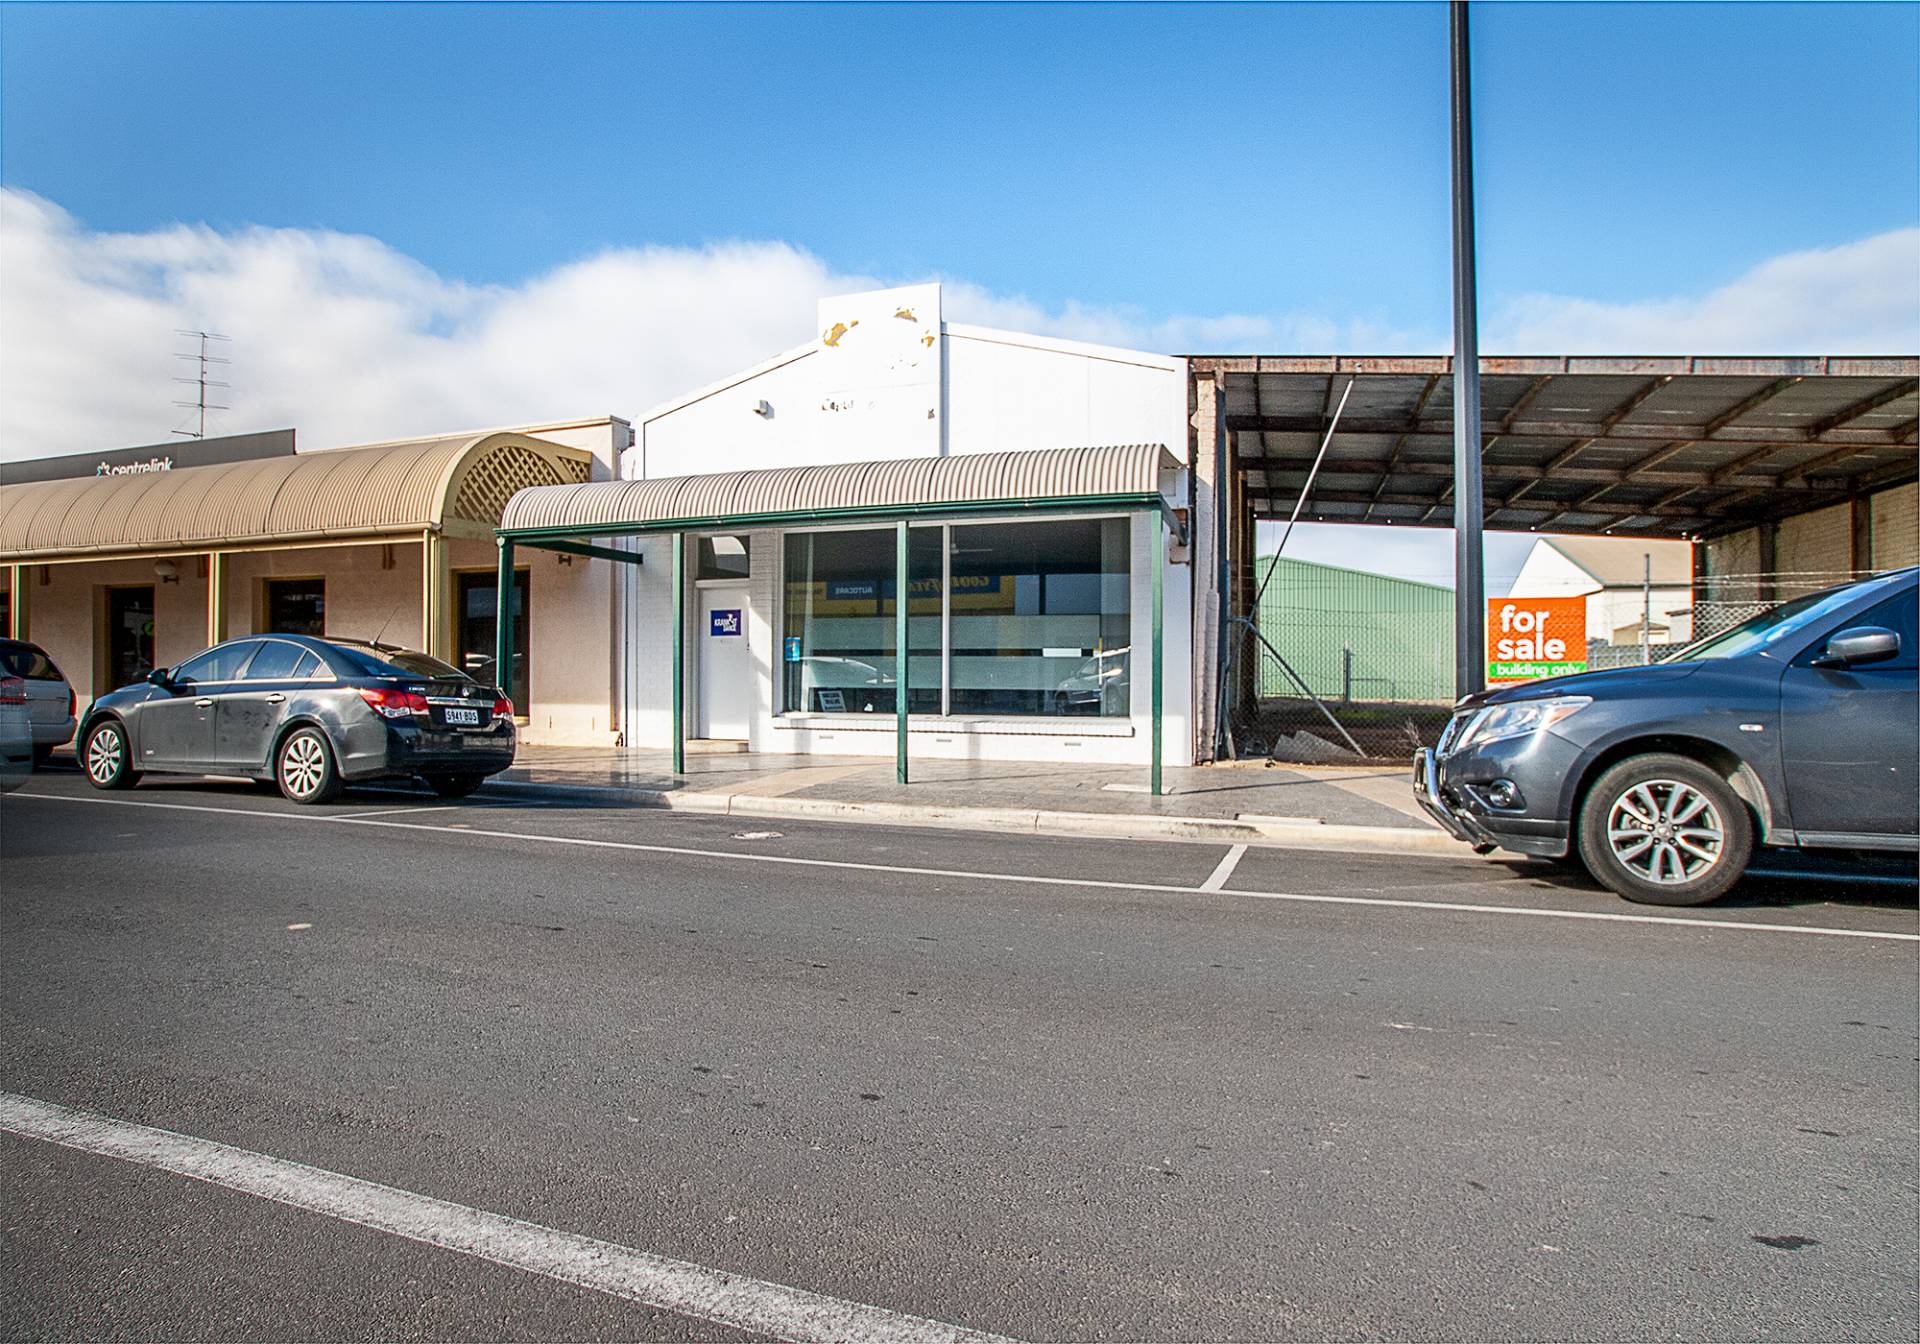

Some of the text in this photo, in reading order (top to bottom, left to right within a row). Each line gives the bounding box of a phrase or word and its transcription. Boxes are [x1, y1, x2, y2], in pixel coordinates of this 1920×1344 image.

[111, 456, 172, 476] centrelink
[1500, 604, 1550, 633] for
[1497, 632, 1566, 660] sale
[1496, 663, 1581, 677] building only
